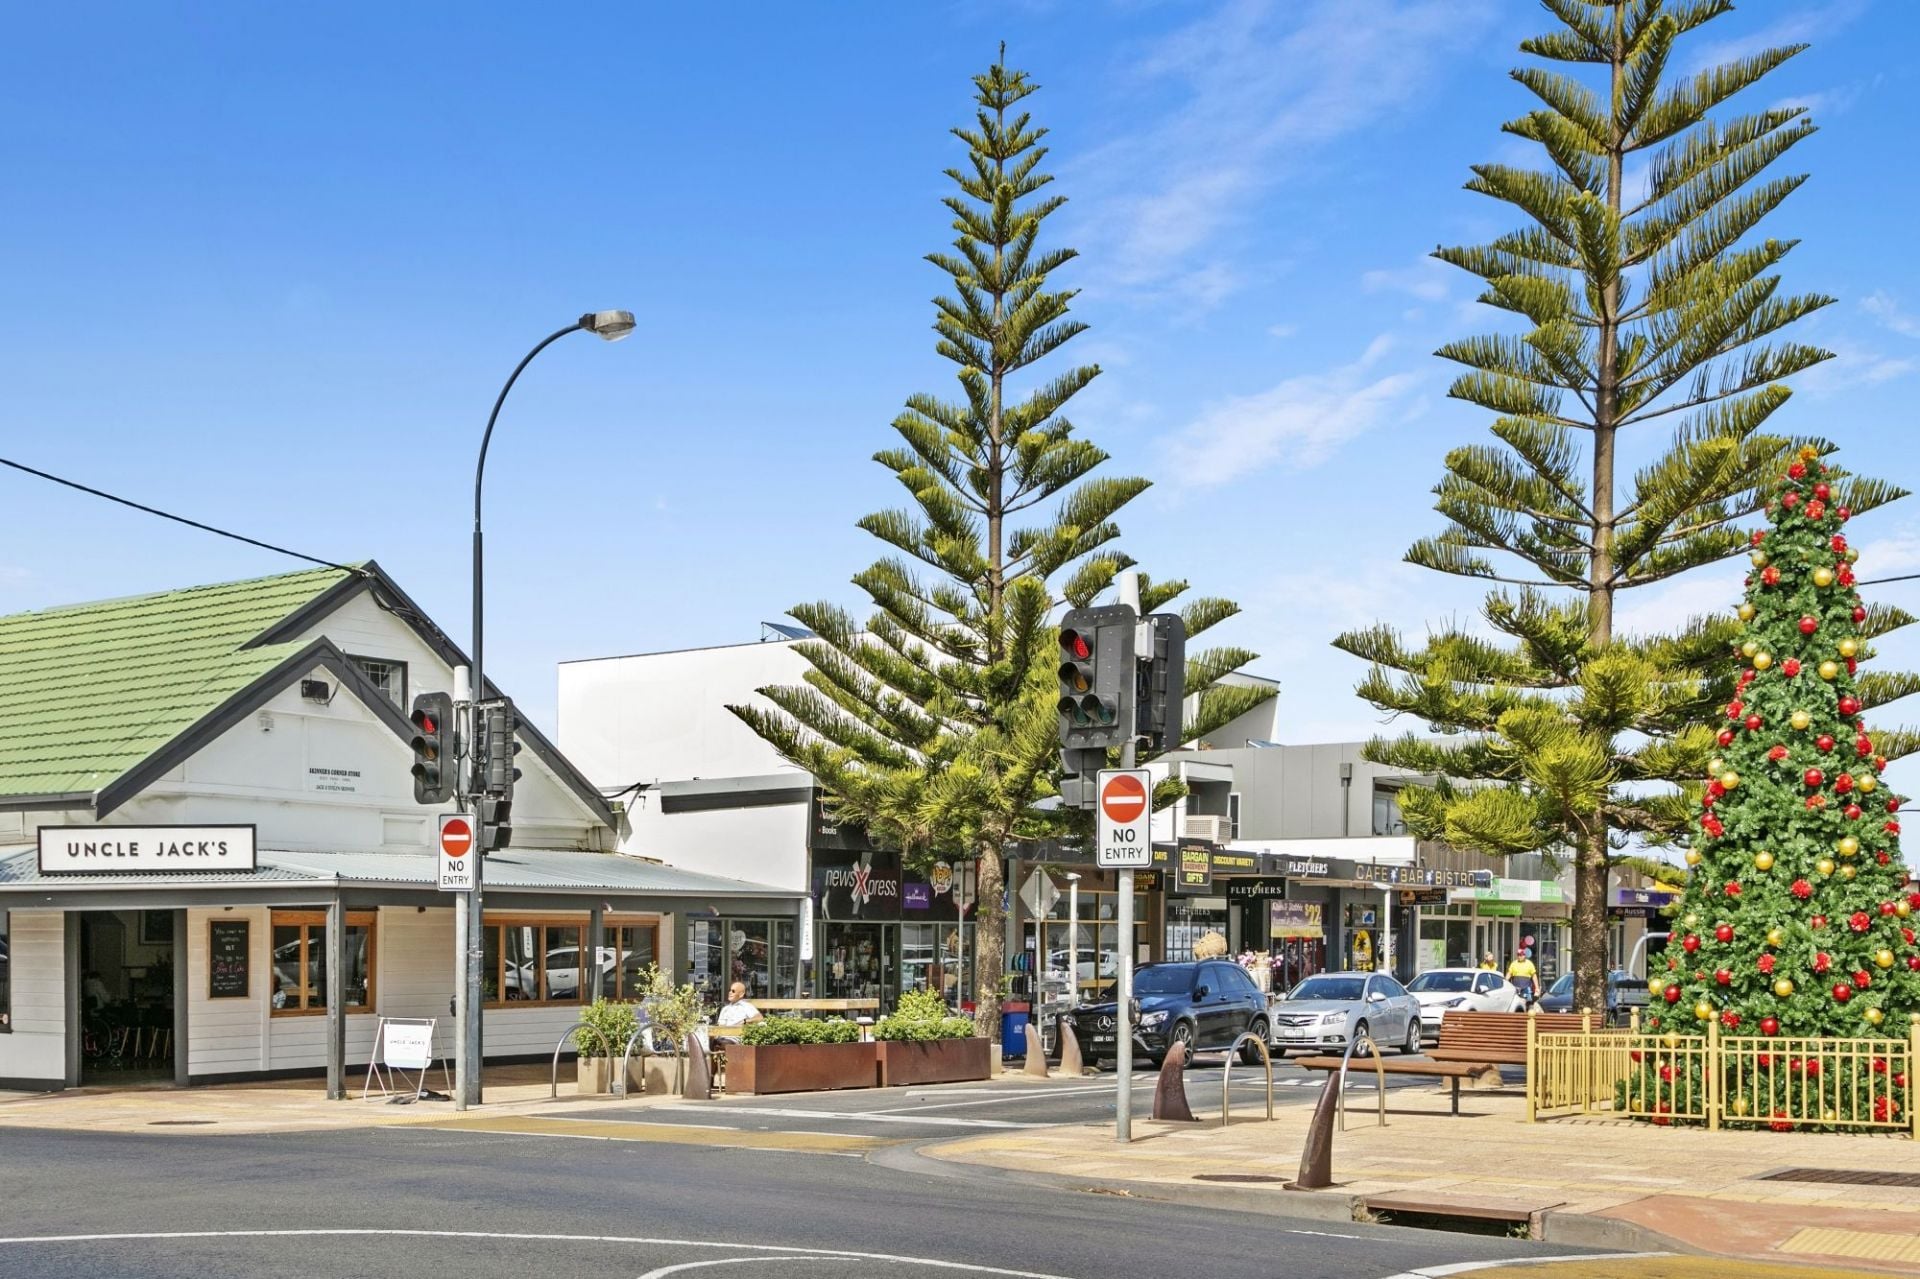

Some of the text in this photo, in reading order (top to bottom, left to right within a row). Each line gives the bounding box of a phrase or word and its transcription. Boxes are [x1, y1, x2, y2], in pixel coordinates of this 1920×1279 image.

[822, 825, 837, 835] Books
[1113, 829, 1136, 843] NO
[67, 841, 228, 857] UNCLE JACK'S
[1105, 847, 1143, 859] ENTRY
[1154, 850, 1168, 861] DAYS
[1182, 850, 1209, 863] BARGAIN
[1213, 855, 1255, 868] DISCOUNT VARIETY
[448, 860, 465, 871] NO
[1183, 863, 1207, 871] BASEMENT
[1288, 858, 1328, 877] FLETCHERS
[442, 875, 469, 885] ENTRY
[1186, 872, 1204, 883] GIFTS
[1356, 865, 1475, 887] CAFE BAR BISTRO
[903, 888, 928, 903] Hallmark
[1230, 884, 1282, 896] FLETCHERS
[1479, 903, 1521, 913] Aromatherapy
[1624, 907, 1646, 917] Aussie
